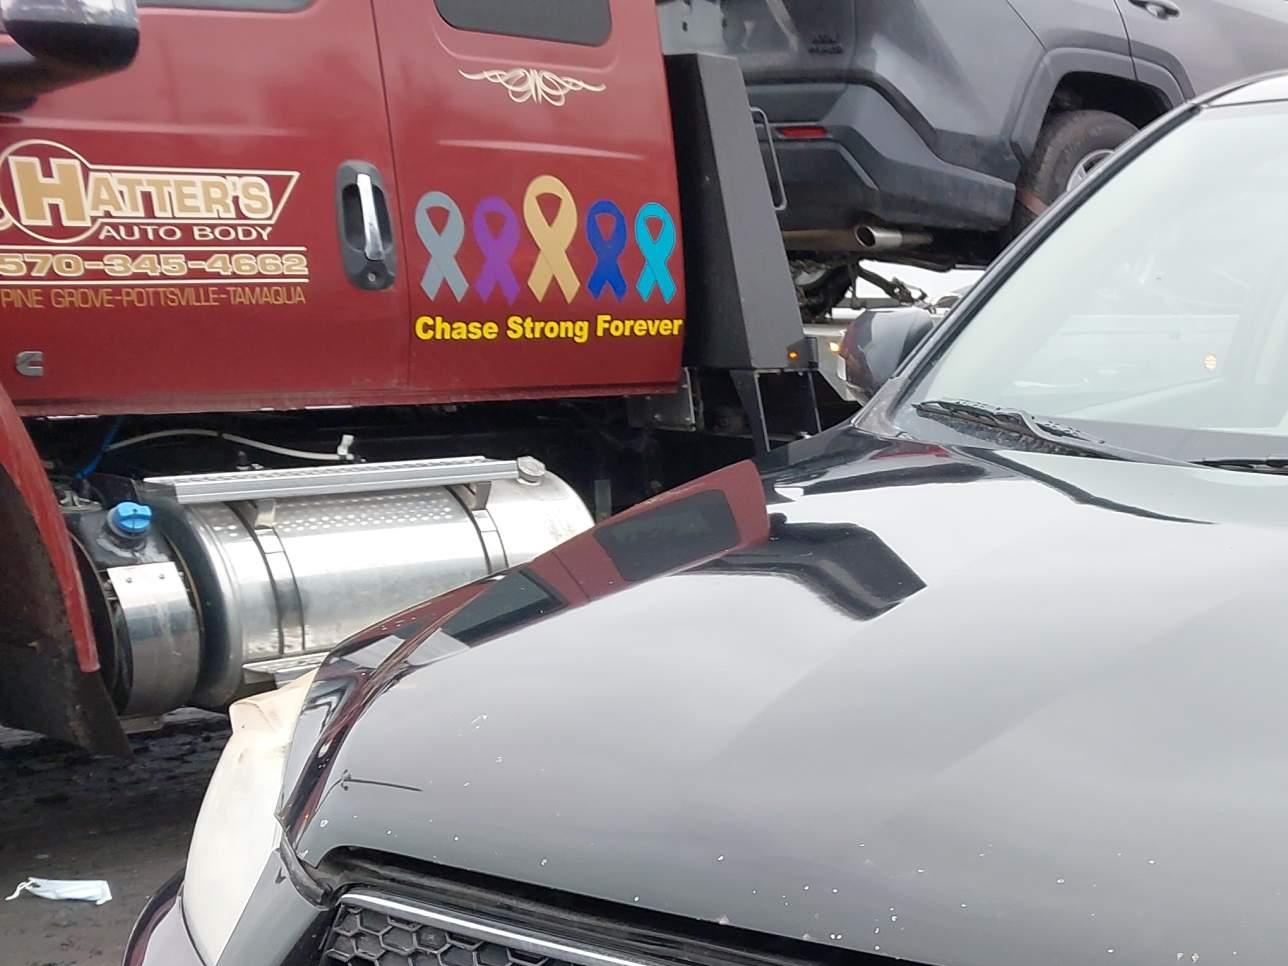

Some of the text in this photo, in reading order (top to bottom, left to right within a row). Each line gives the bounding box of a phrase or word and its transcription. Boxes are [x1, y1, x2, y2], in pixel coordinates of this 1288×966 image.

[99, 226, 272, 241] AUTO BODY
[0, 253, 308, 277] 570-345-4662
[1, 286, 306, 308] PINE GROVE-POTTSVILLE-TAMAQUA
[415, 315, 683, 343] Chase Strong Forever
